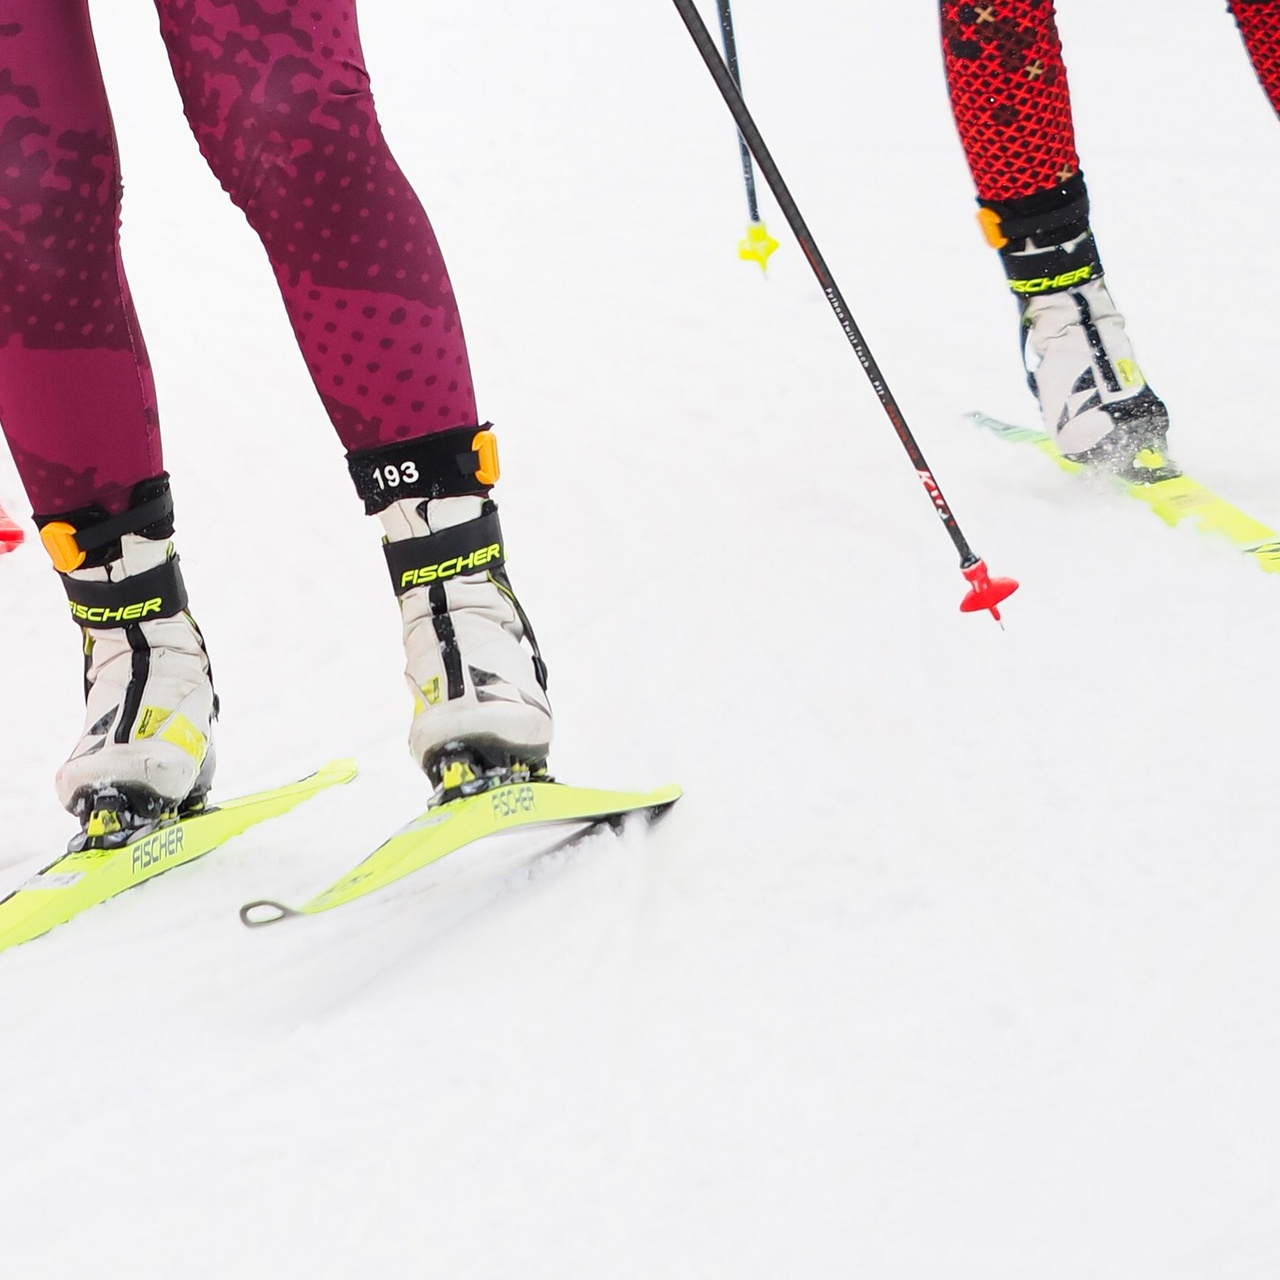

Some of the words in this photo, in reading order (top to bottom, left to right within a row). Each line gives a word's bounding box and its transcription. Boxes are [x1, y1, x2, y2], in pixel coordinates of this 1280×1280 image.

[372, 460, 420, 490] 193
[401, 543, 500, 588] FISCHER
[492, 786, 537, 820] FISCHER
[132, 826, 186, 875] FISCHER
